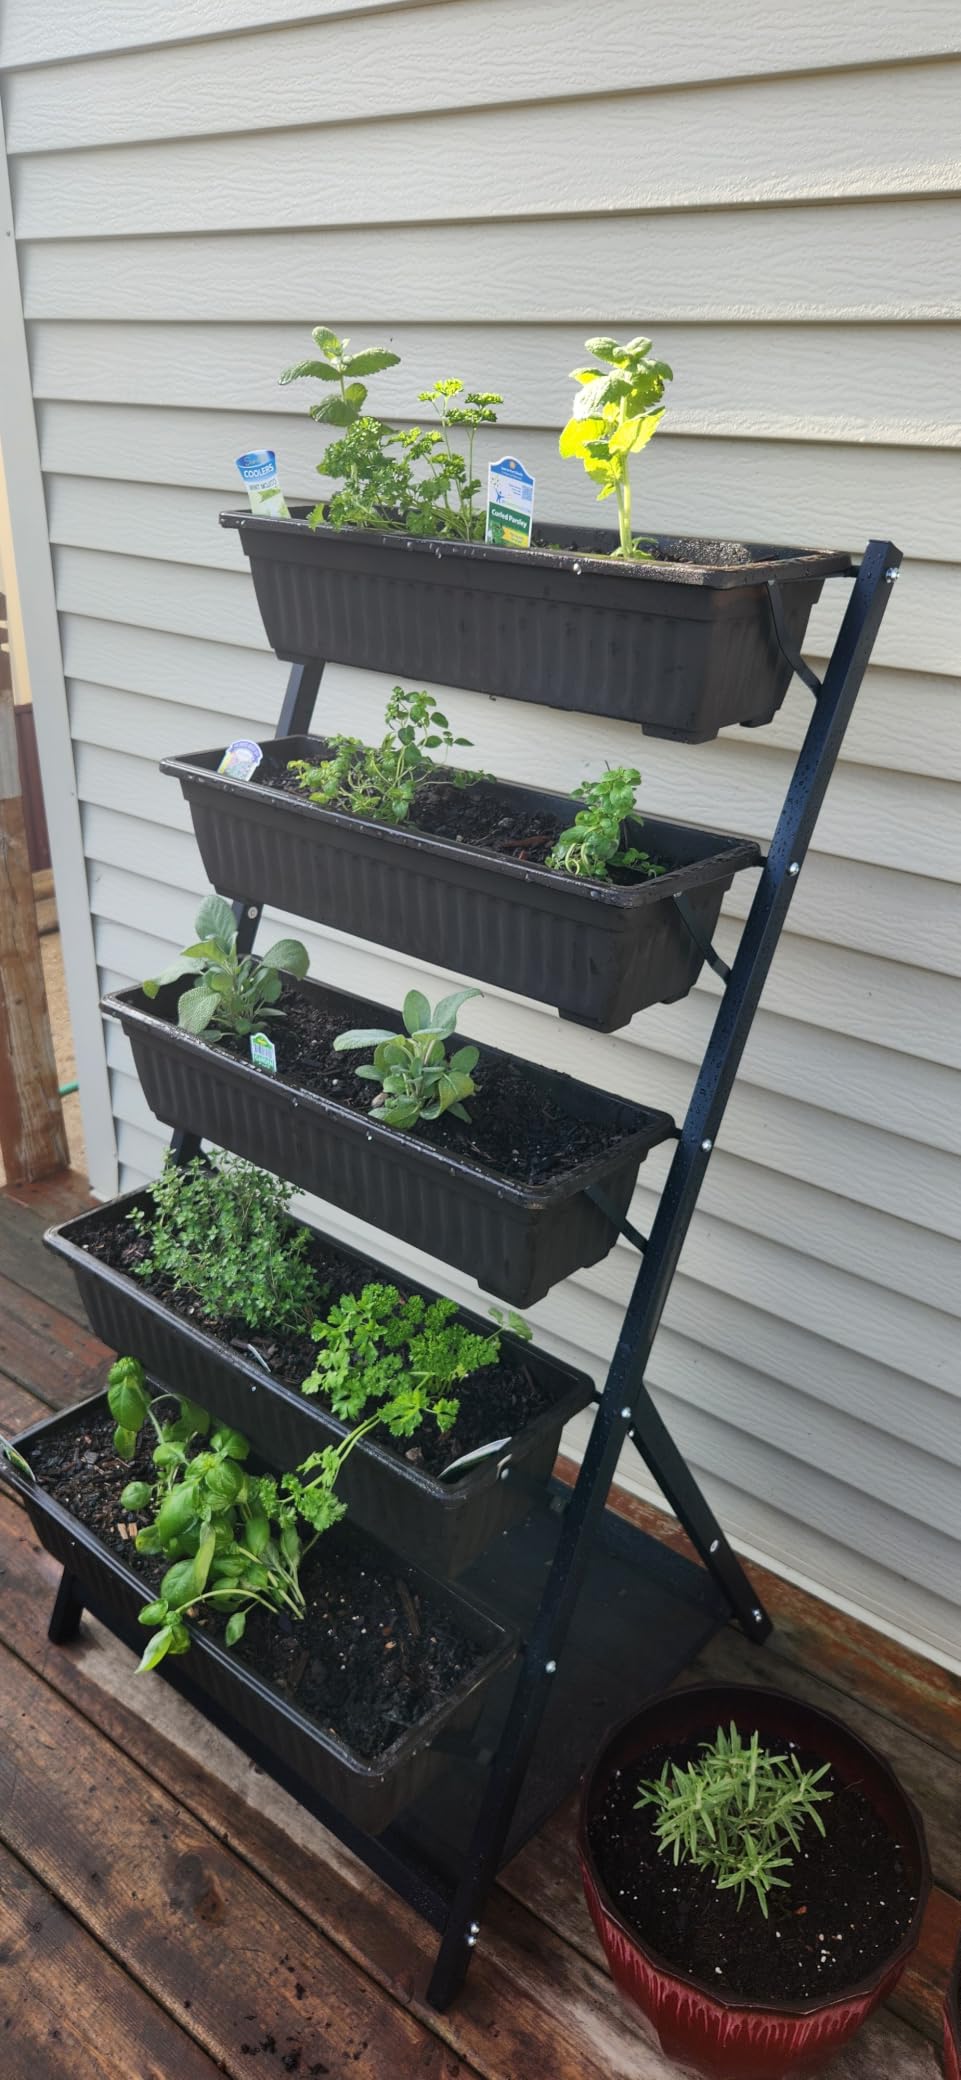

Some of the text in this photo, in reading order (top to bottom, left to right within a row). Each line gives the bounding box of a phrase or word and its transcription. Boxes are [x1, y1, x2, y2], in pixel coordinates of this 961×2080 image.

[244, 464, 274, 478] COOLERS
[491, 509, 527, 528] Curled Parsley
